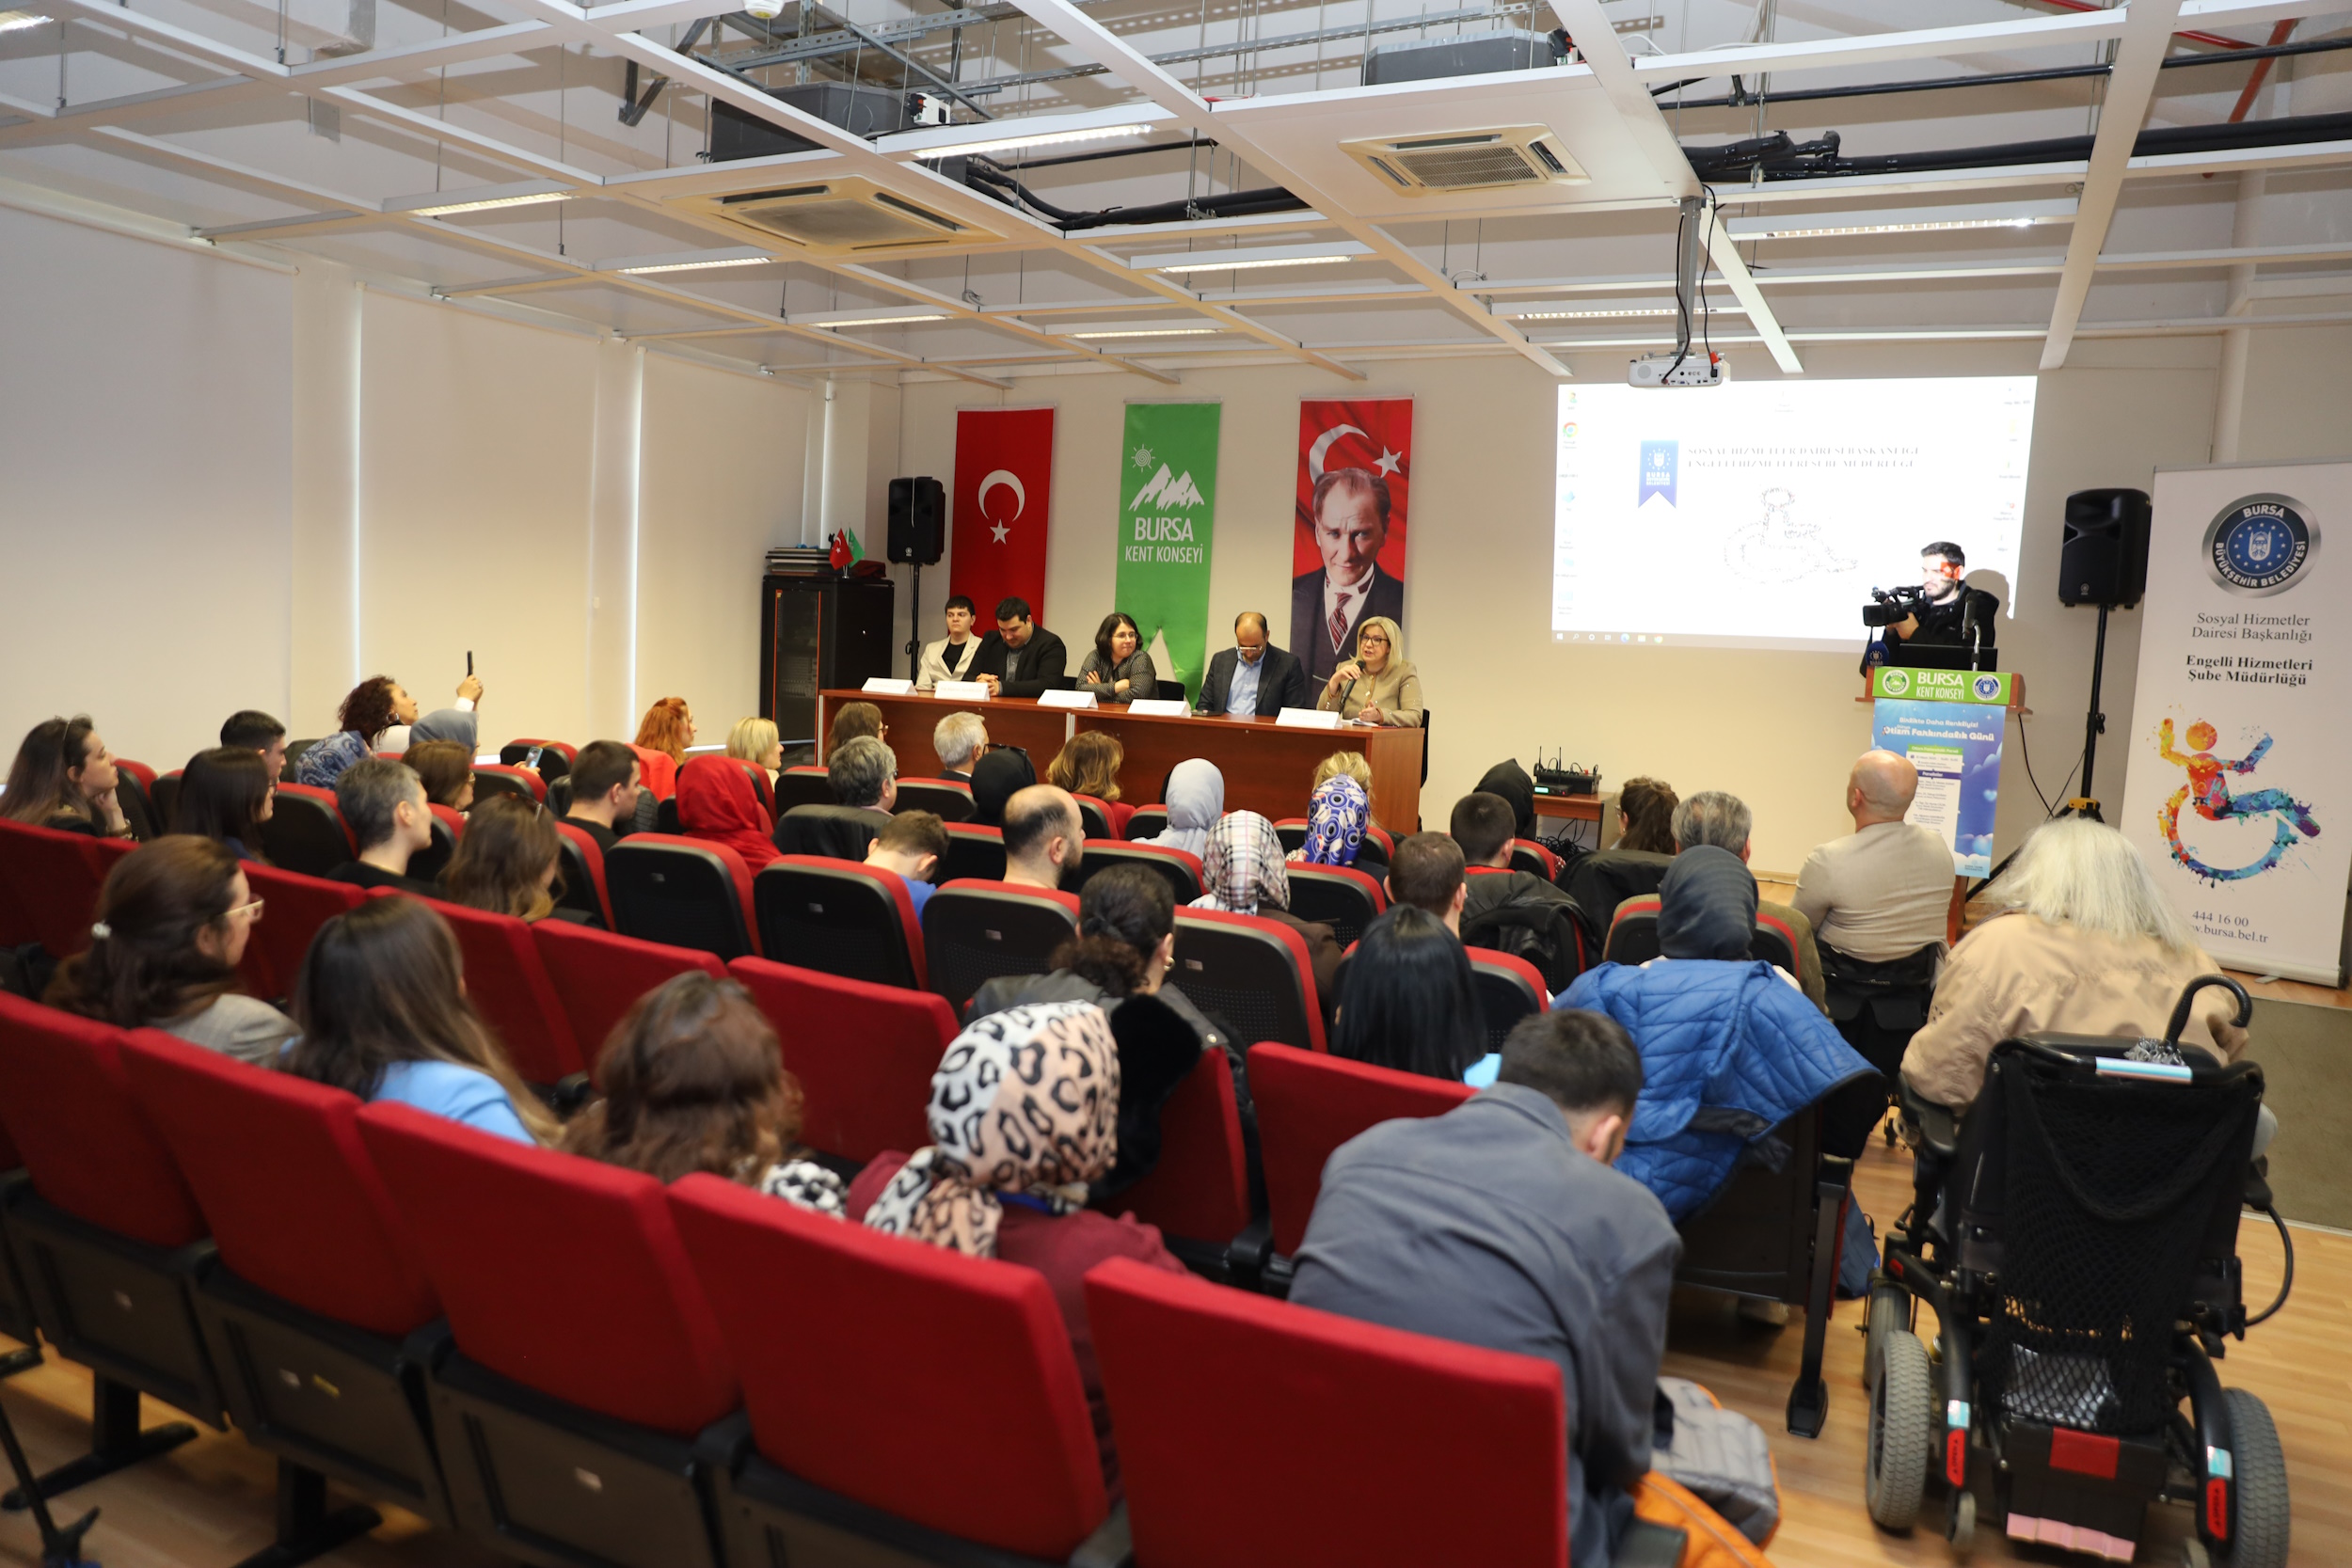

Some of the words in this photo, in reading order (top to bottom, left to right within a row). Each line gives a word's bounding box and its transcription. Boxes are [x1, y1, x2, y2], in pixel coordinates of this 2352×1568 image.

[2242, 504, 2284, 518] BURSA
[1135, 516, 1194, 542] BURSA
[1125, 546, 1154, 562] KENT
[1156, 543, 1203, 563] KONSEYİ
[2216, 542, 2258, 588] BÜYÜKŞEHİR
[2261, 540, 2306, 587] BELEDİYESİ
[2197, 612, 2239, 626] Sosyal
[2243, 613, 2311, 626] Hizmetler
[2191, 626, 2237, 640] Dairesi
[2241, 627, 2312, 643] Başkanlığı
[2185, 655, 2233, 669] Engelli
[2237, 657, 2313, 671] Hizmetleri
[1916, 671, 1965, 687] BURSA
[2187, 668, 2222, 682] Şube
[2225, 670, 2307, 688] Müdürlüğü
[1915, 686, 1934, 698] KENT
[1934, 686, 1964, 700] KONSEYİ
[1883, 726, 1910, 736] Otizm
[1968, 732, 1994, 741] Günü
[2192, 911, 2213, 922] 444
[2218, 914, 2231, 925] 16
[2233, 916, 2249, 927] 00
[2191, 924, 2269, 943] w.bursa.bel.tr
